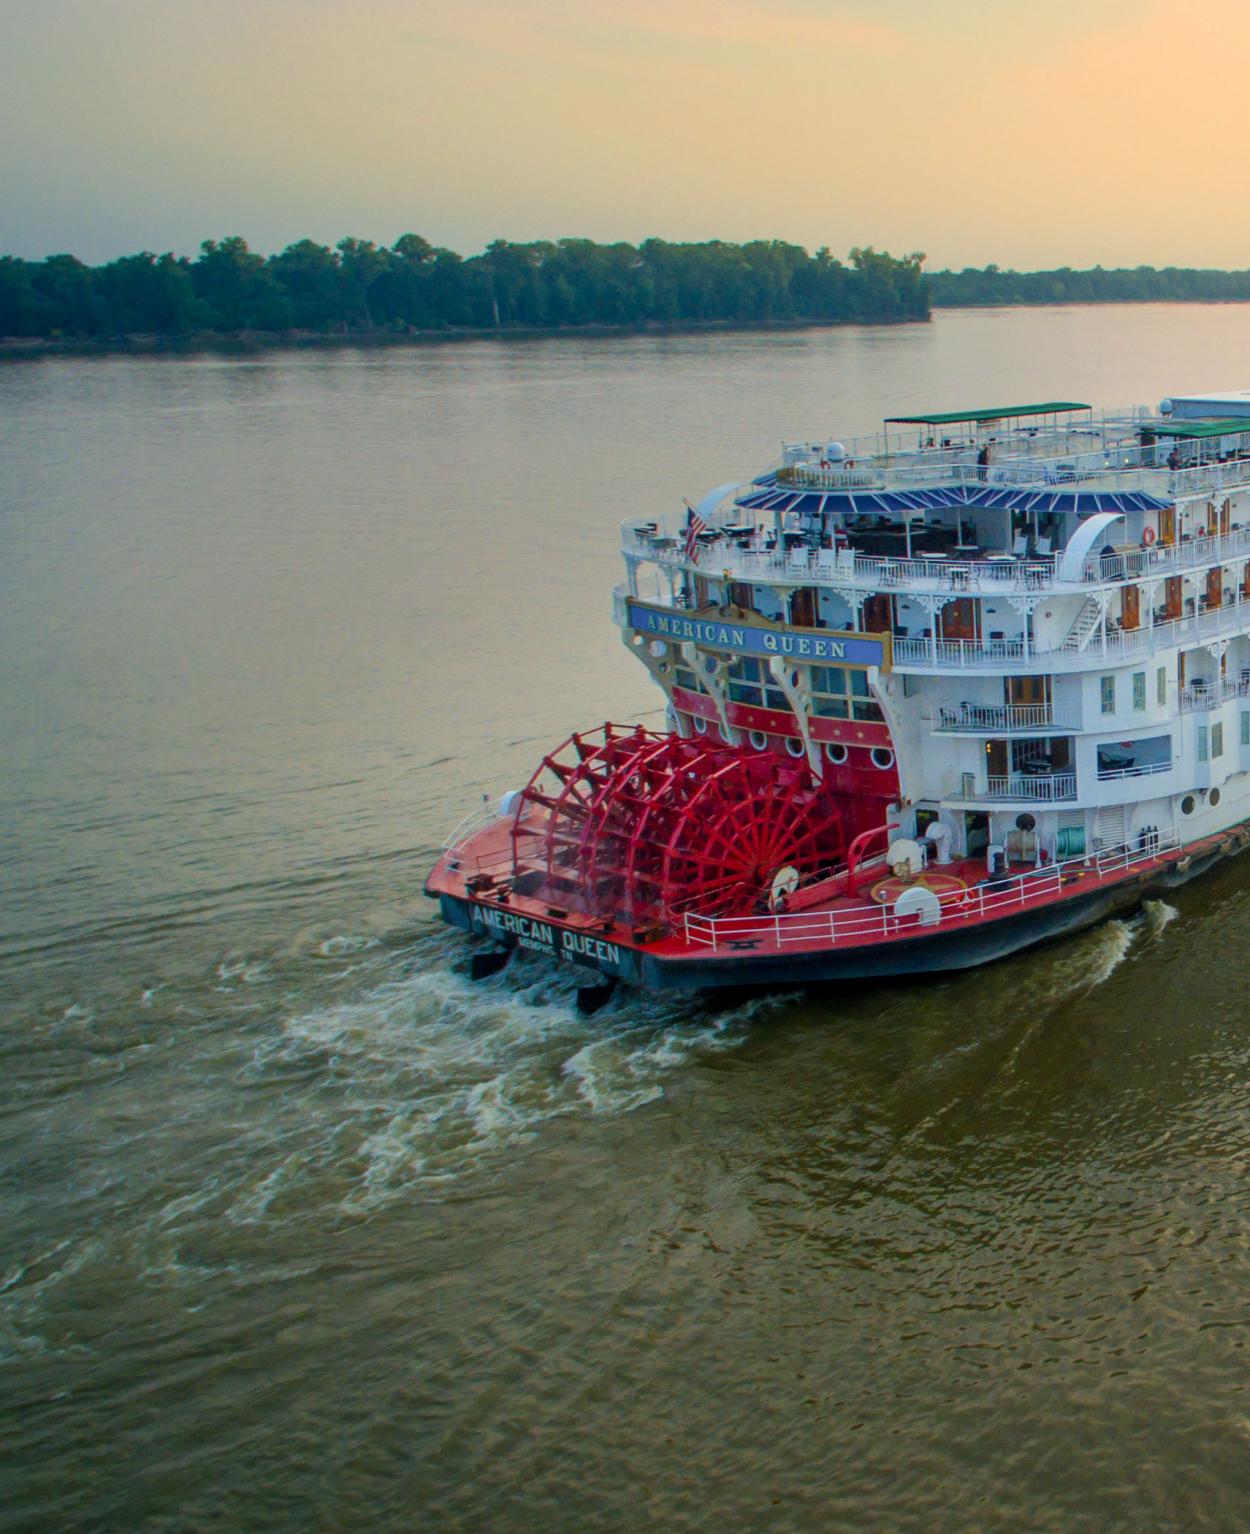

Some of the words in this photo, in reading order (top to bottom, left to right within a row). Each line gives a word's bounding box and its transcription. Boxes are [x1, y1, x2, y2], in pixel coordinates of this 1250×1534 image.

[648, 615, 745, 646] AMERICAN
[764, 634, 846, 658] QUEEN
[473, 905, 553, 945] AMERICAN
[562, 931, 620, 965] QUEEN
